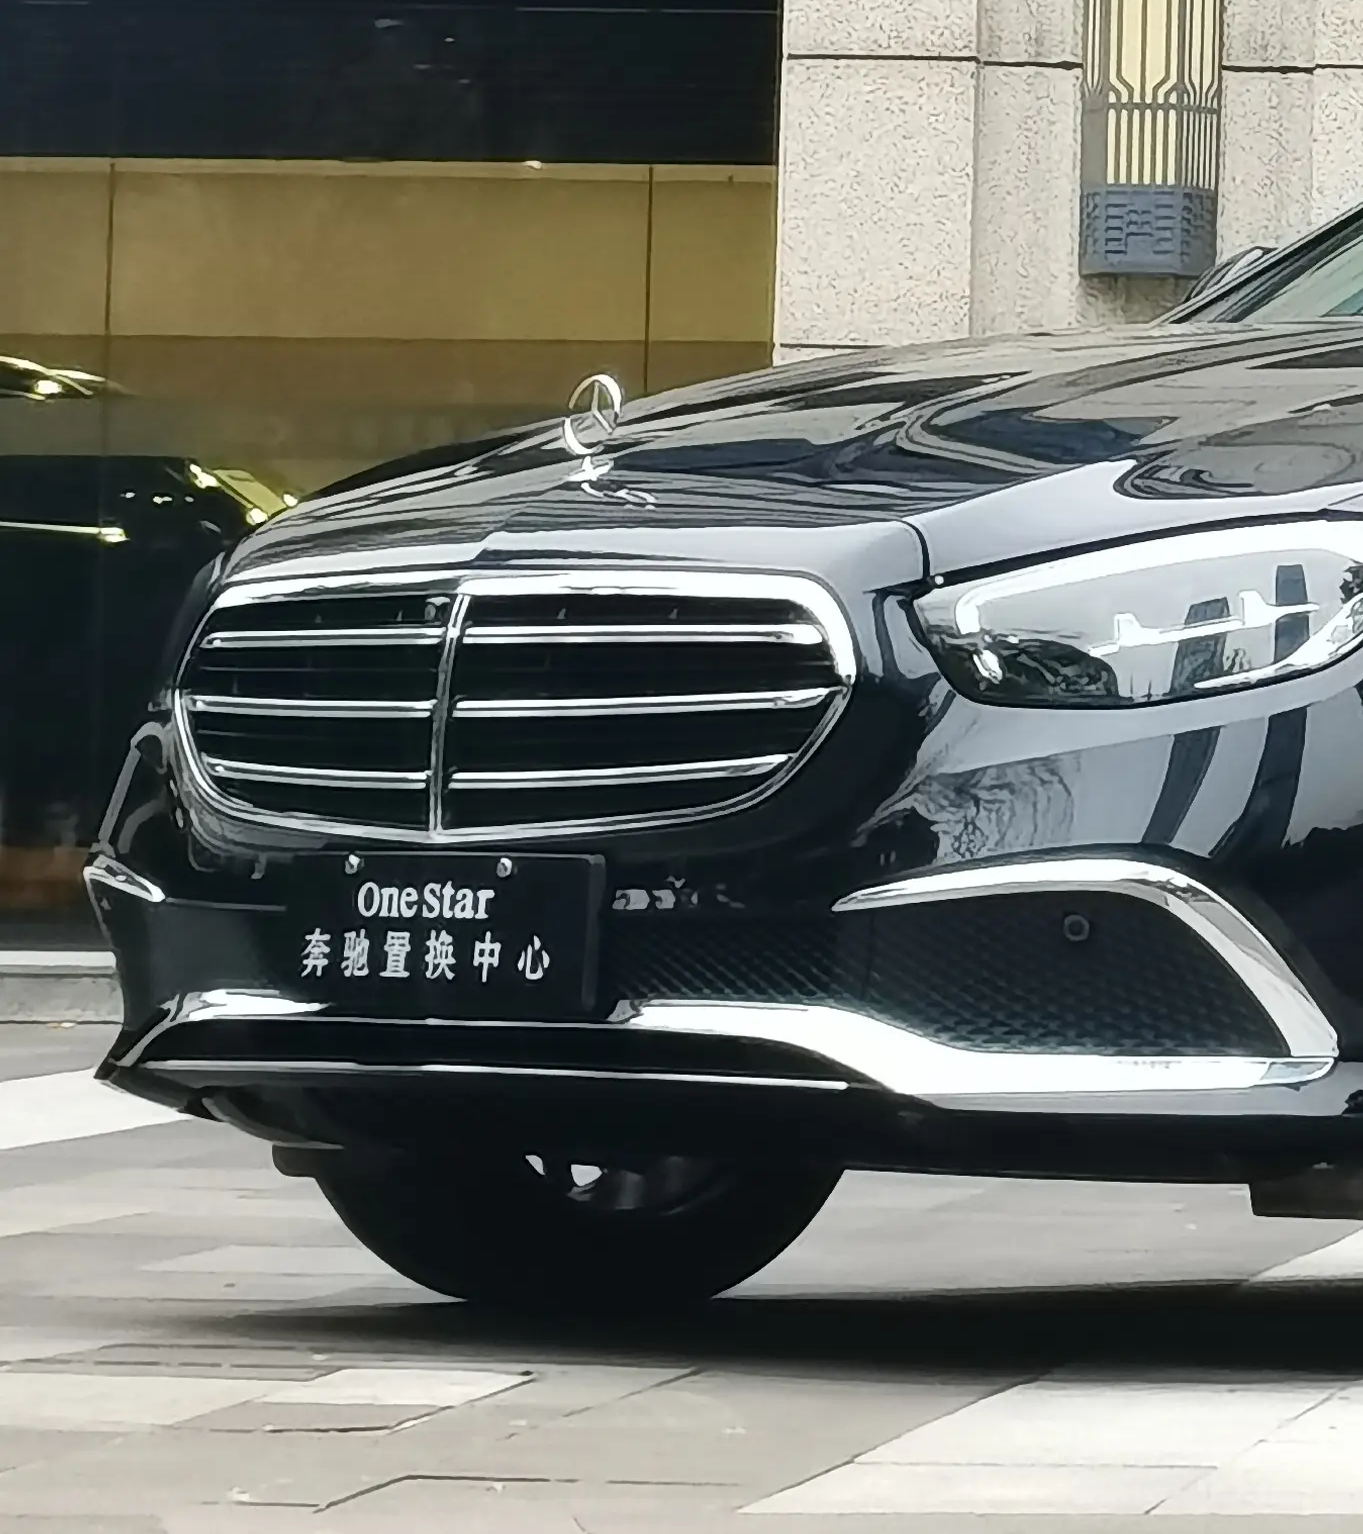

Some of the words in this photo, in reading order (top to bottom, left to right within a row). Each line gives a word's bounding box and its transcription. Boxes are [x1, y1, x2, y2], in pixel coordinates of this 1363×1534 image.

[300, 927, 551, 983] 奔驰置换中心
